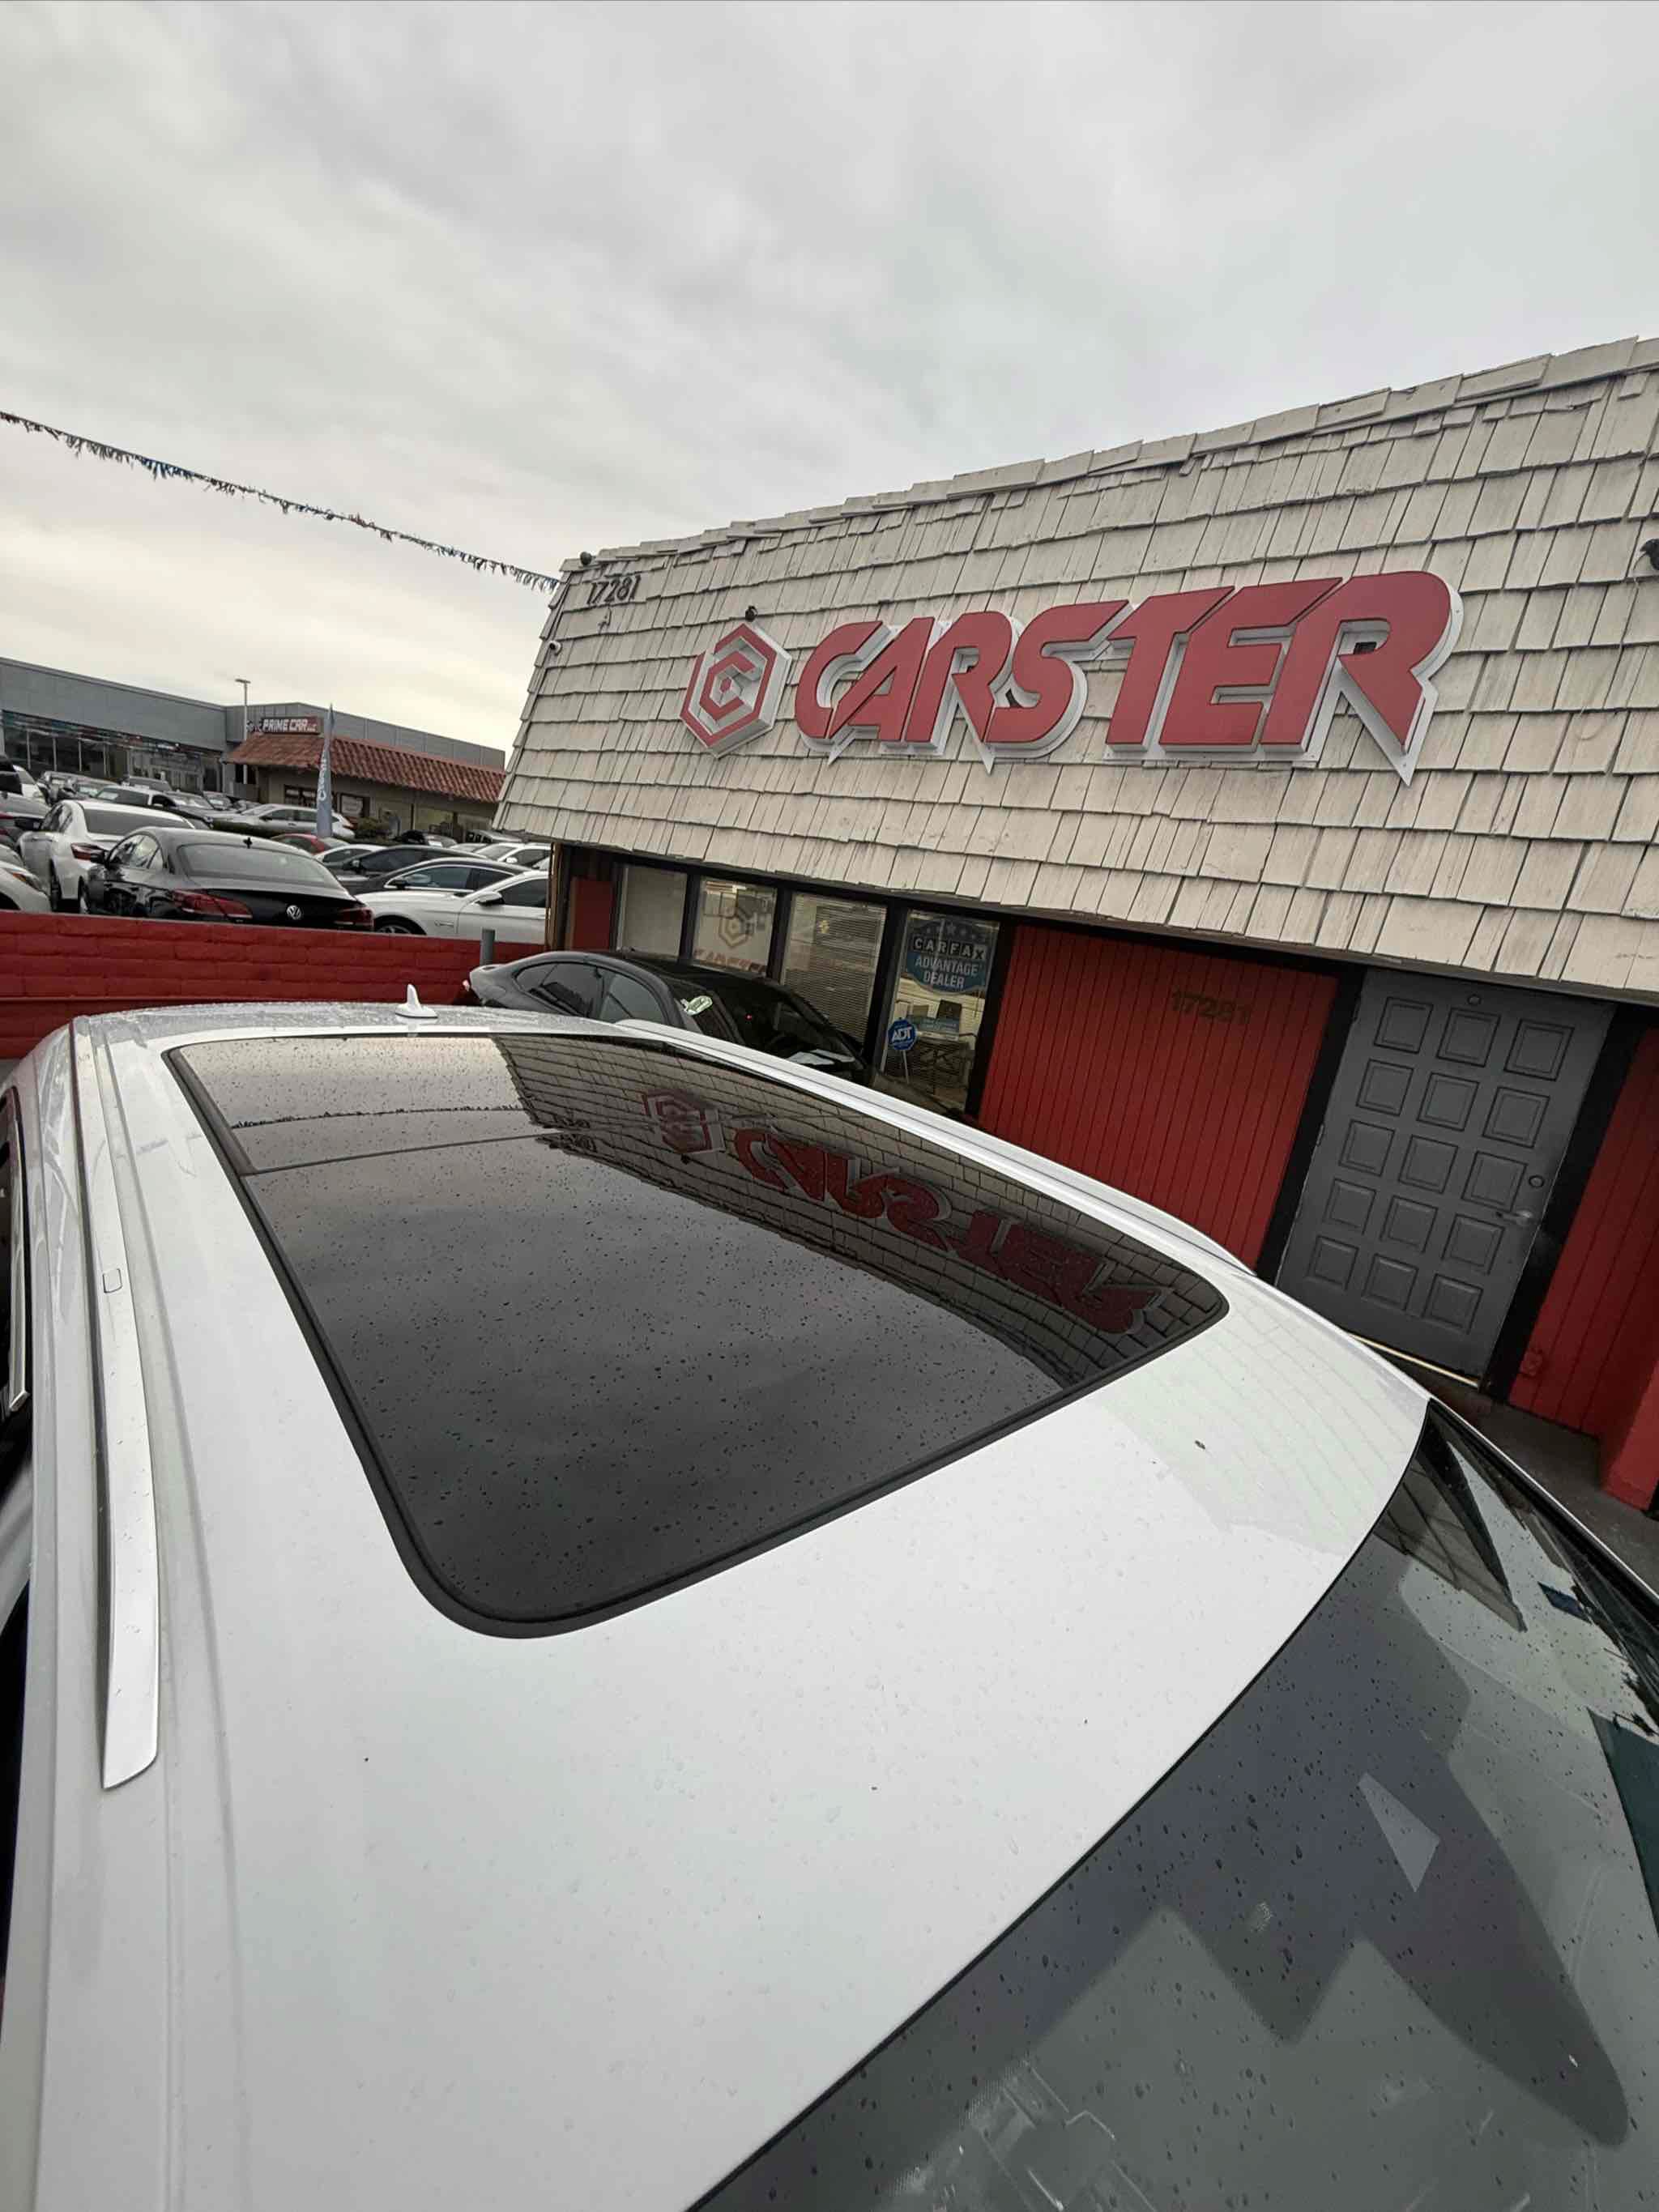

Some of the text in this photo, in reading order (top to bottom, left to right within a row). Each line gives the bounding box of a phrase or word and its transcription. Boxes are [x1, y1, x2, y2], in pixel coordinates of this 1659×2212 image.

[586, 574, 641, 605] 17281
[795, 571, 1454, 753] CARSTER
[262, 718, 288, 732] PRIME
[914, 937, 986, 960] CARFAX
[915, 955, 979, 977] ADVANTAGE
[923, 970, 965, 989] DEALER
[892, 1026, 913, 1042] ADT
